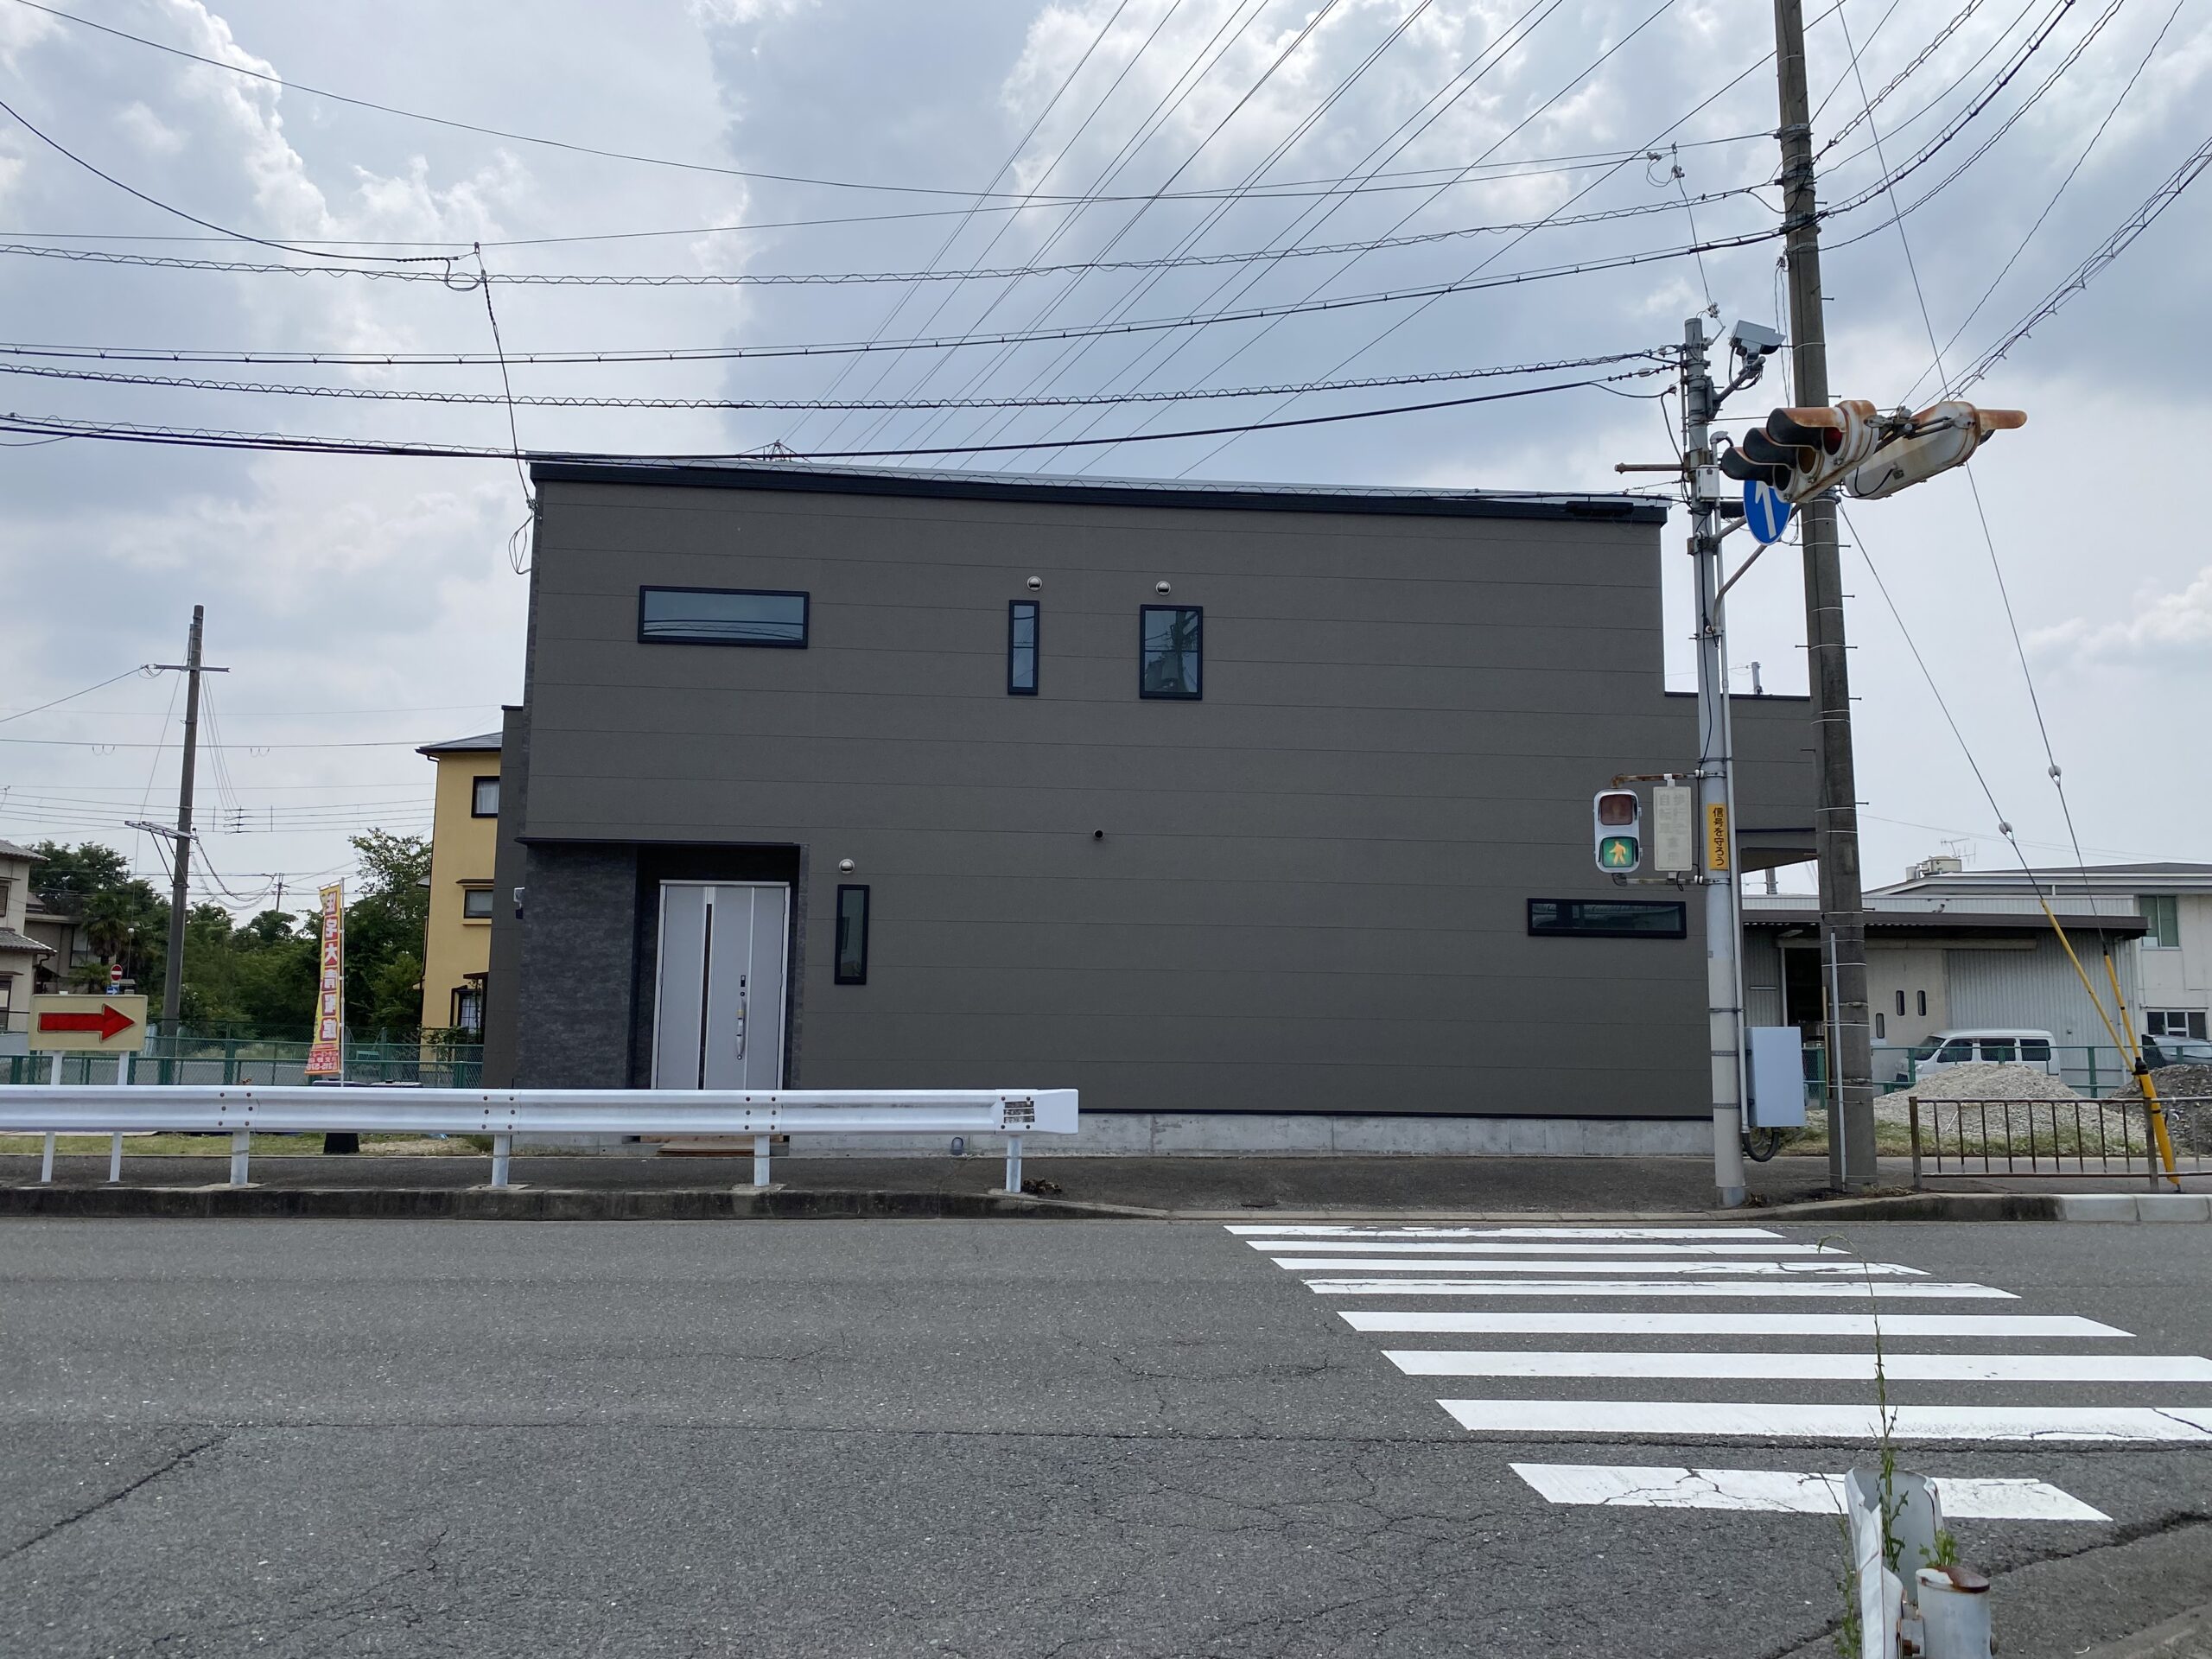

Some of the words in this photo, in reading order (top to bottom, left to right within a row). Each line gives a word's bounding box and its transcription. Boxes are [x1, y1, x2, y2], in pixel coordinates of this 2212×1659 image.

[1713, 807, 1725, 867] 信号を守ろう
